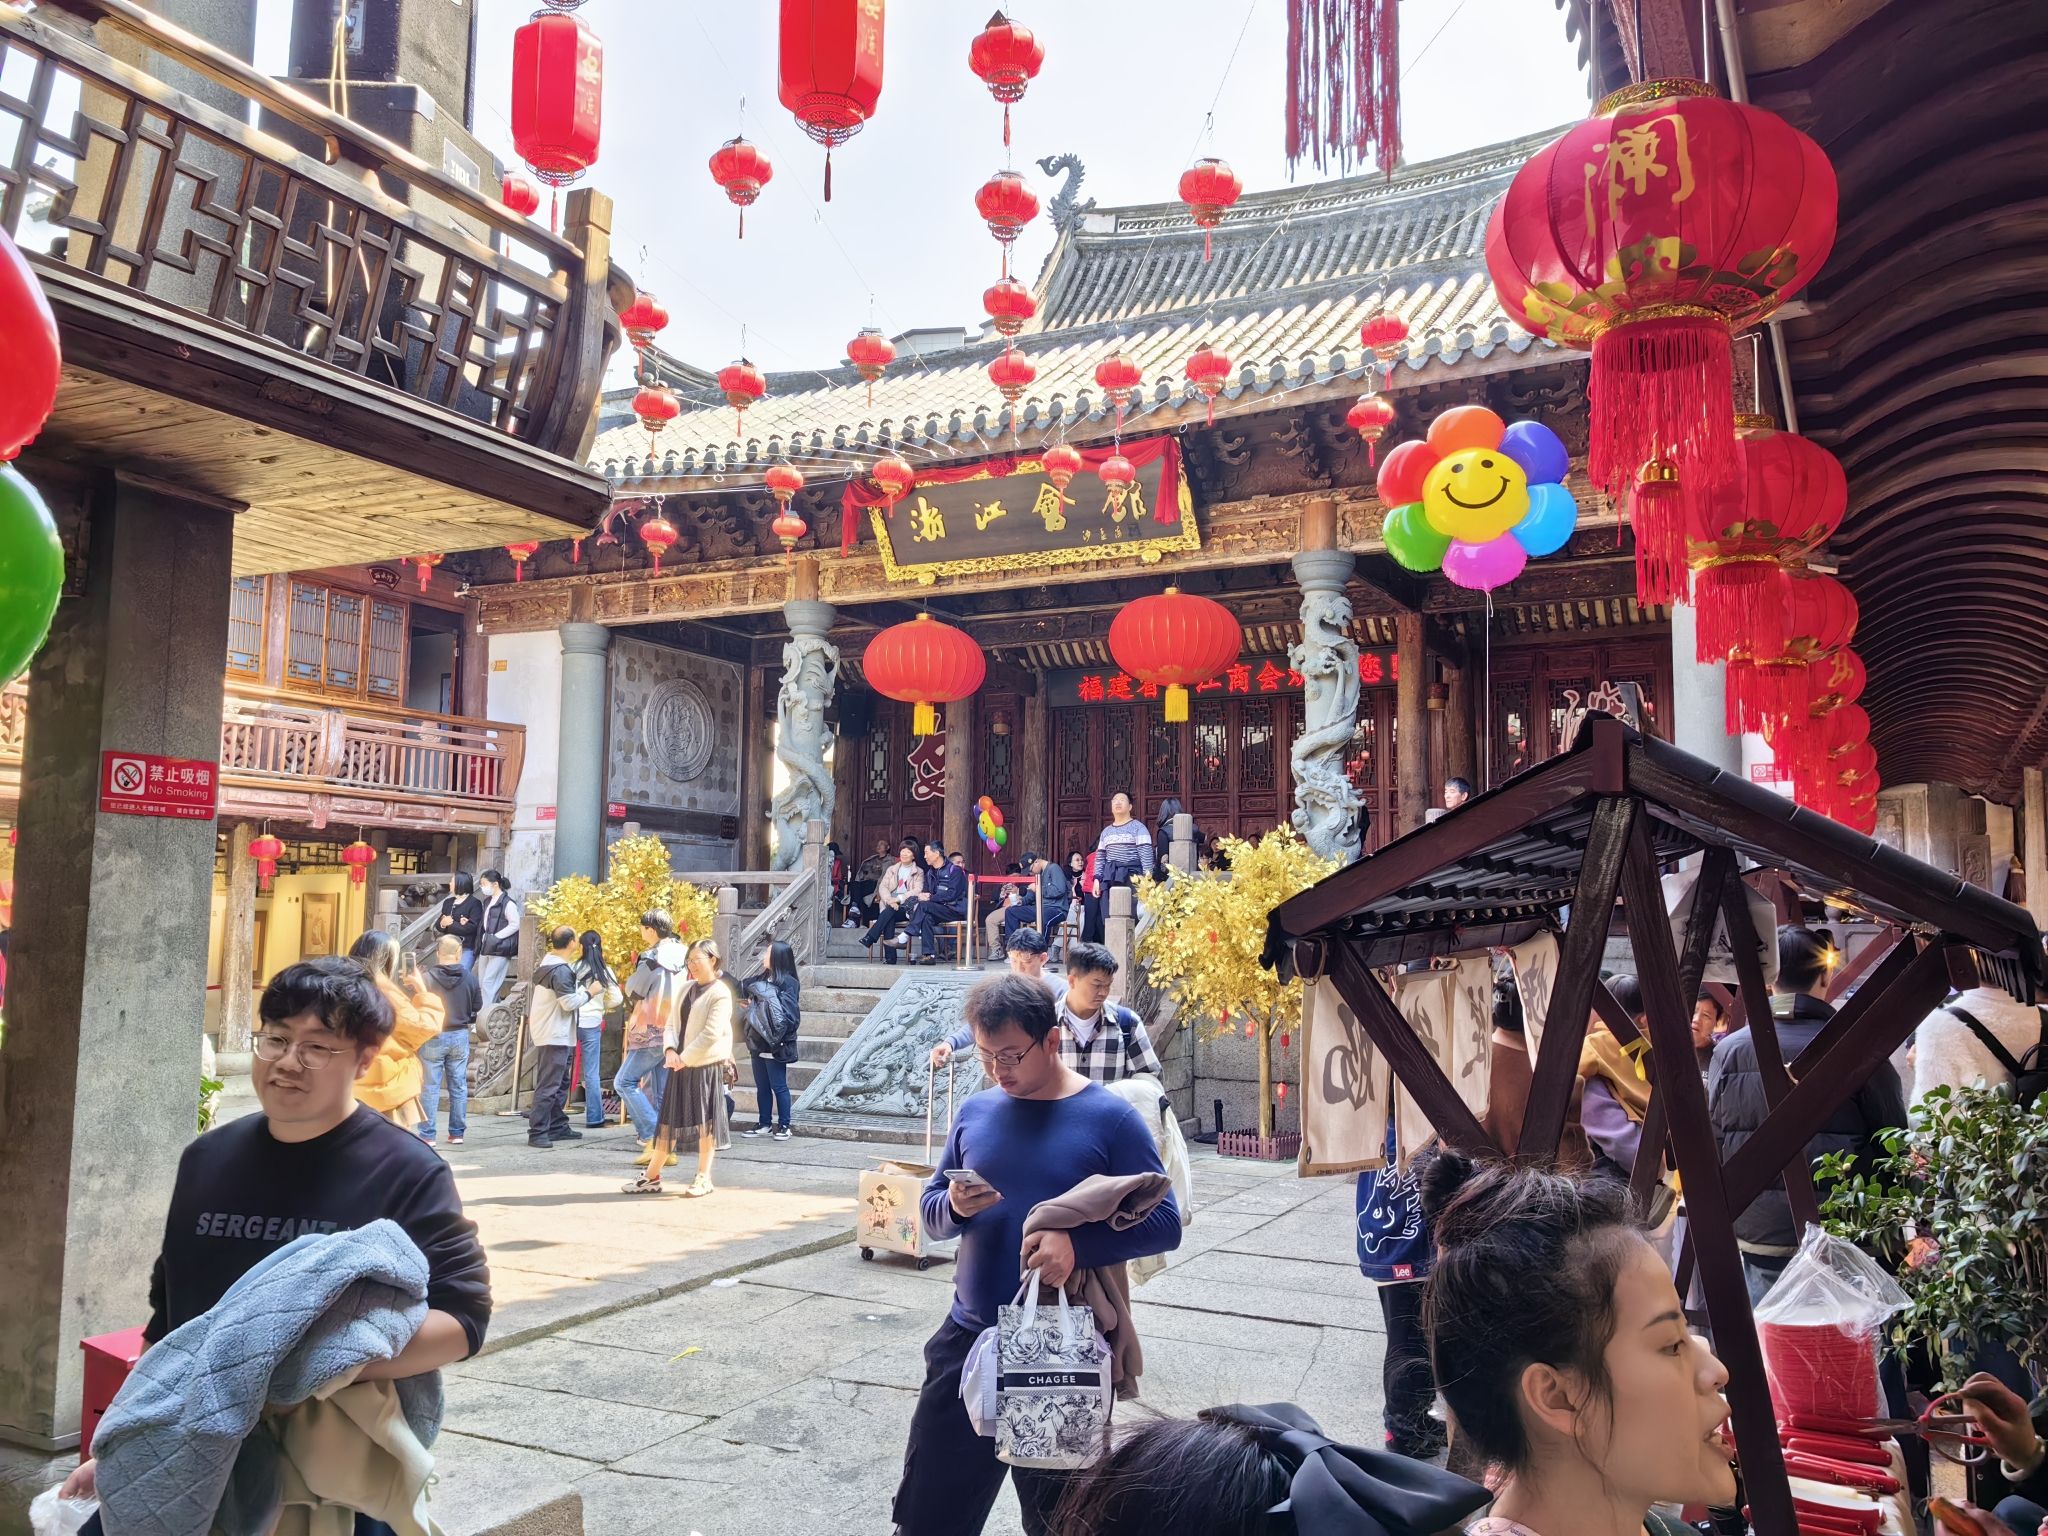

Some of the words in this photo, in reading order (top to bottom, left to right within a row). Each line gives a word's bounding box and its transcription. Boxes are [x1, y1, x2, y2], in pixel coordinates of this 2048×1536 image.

[150, 764, 210, 786] 禁止吸烟
[148, 785, 163, 795] No
[166, 788, 209, 800] Smoking
[1394, 1267, 1411, 1277] Lee
[1028, 1375, 1077, 1385] CHAGEE
